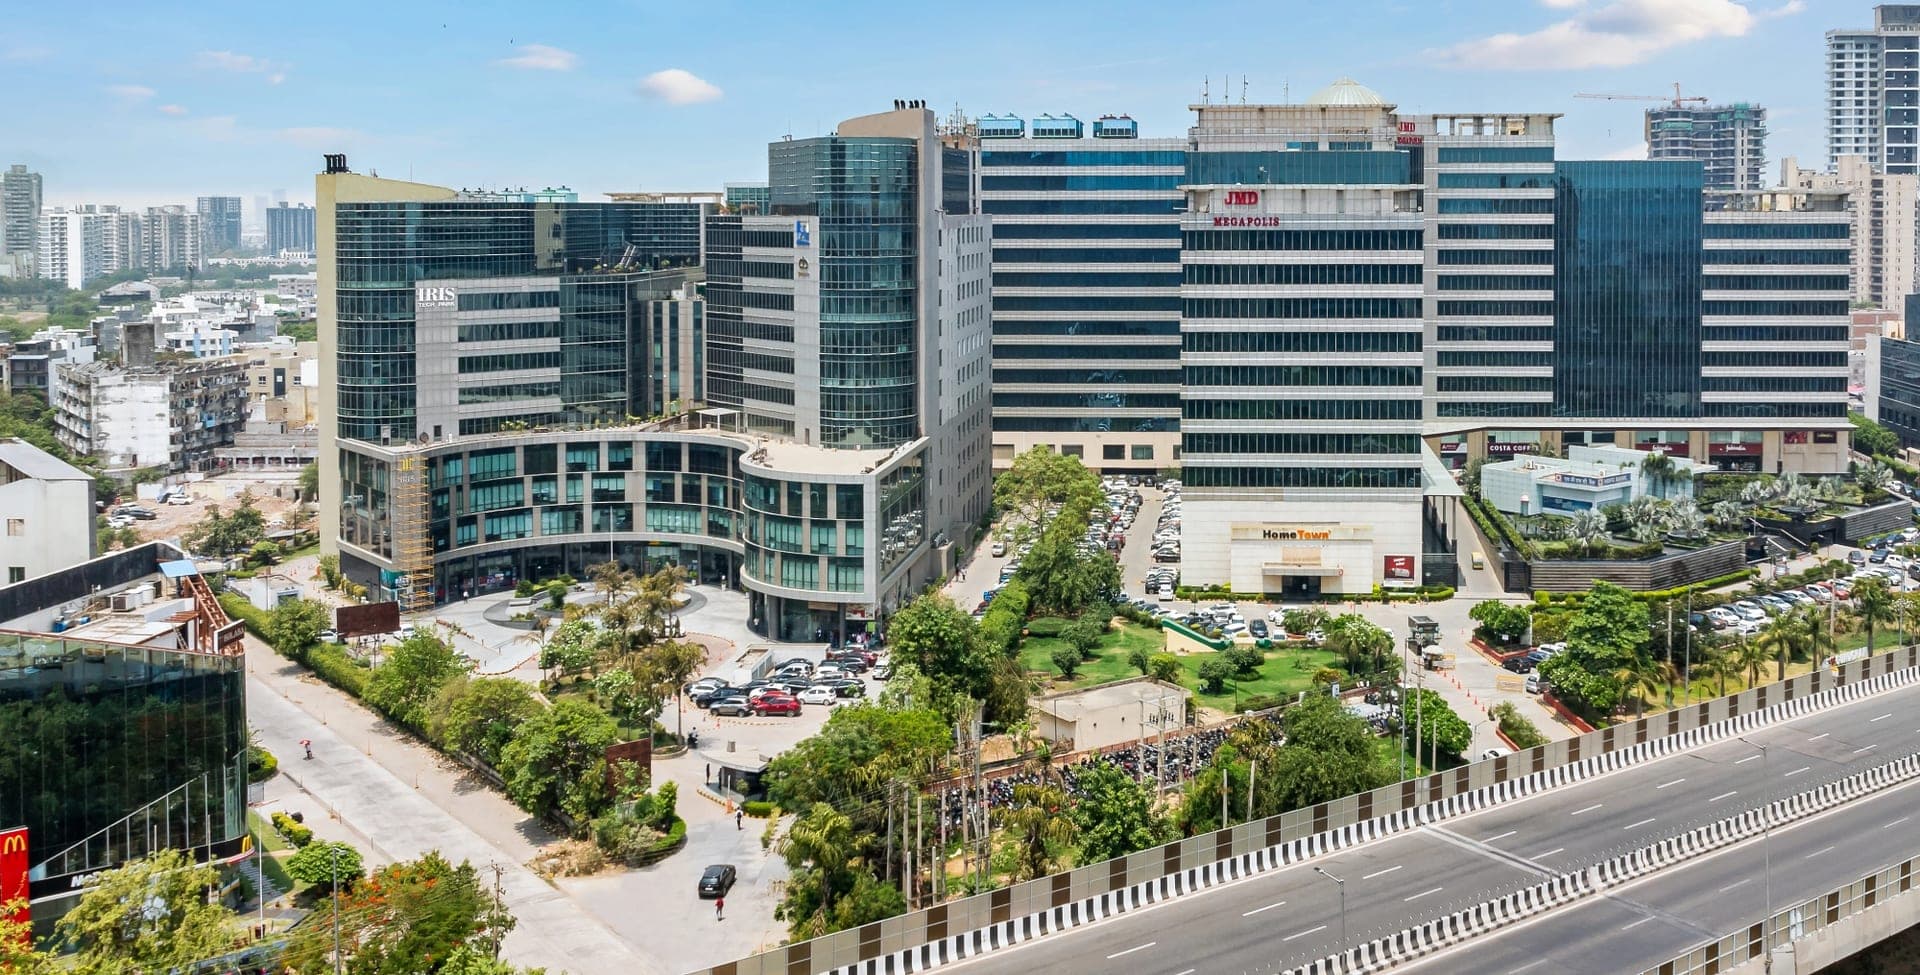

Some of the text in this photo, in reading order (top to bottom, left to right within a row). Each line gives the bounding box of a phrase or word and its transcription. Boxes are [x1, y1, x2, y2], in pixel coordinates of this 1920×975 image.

[1399, 121, 1416, 132] JMD
[1224, 191, 1259, 205] JMD
[1213, 216, 1280, 227] MEGAPOLIS
[418, 287, 455, 301] IRIS
[1262, 529, 1329, 540] HomeTown
